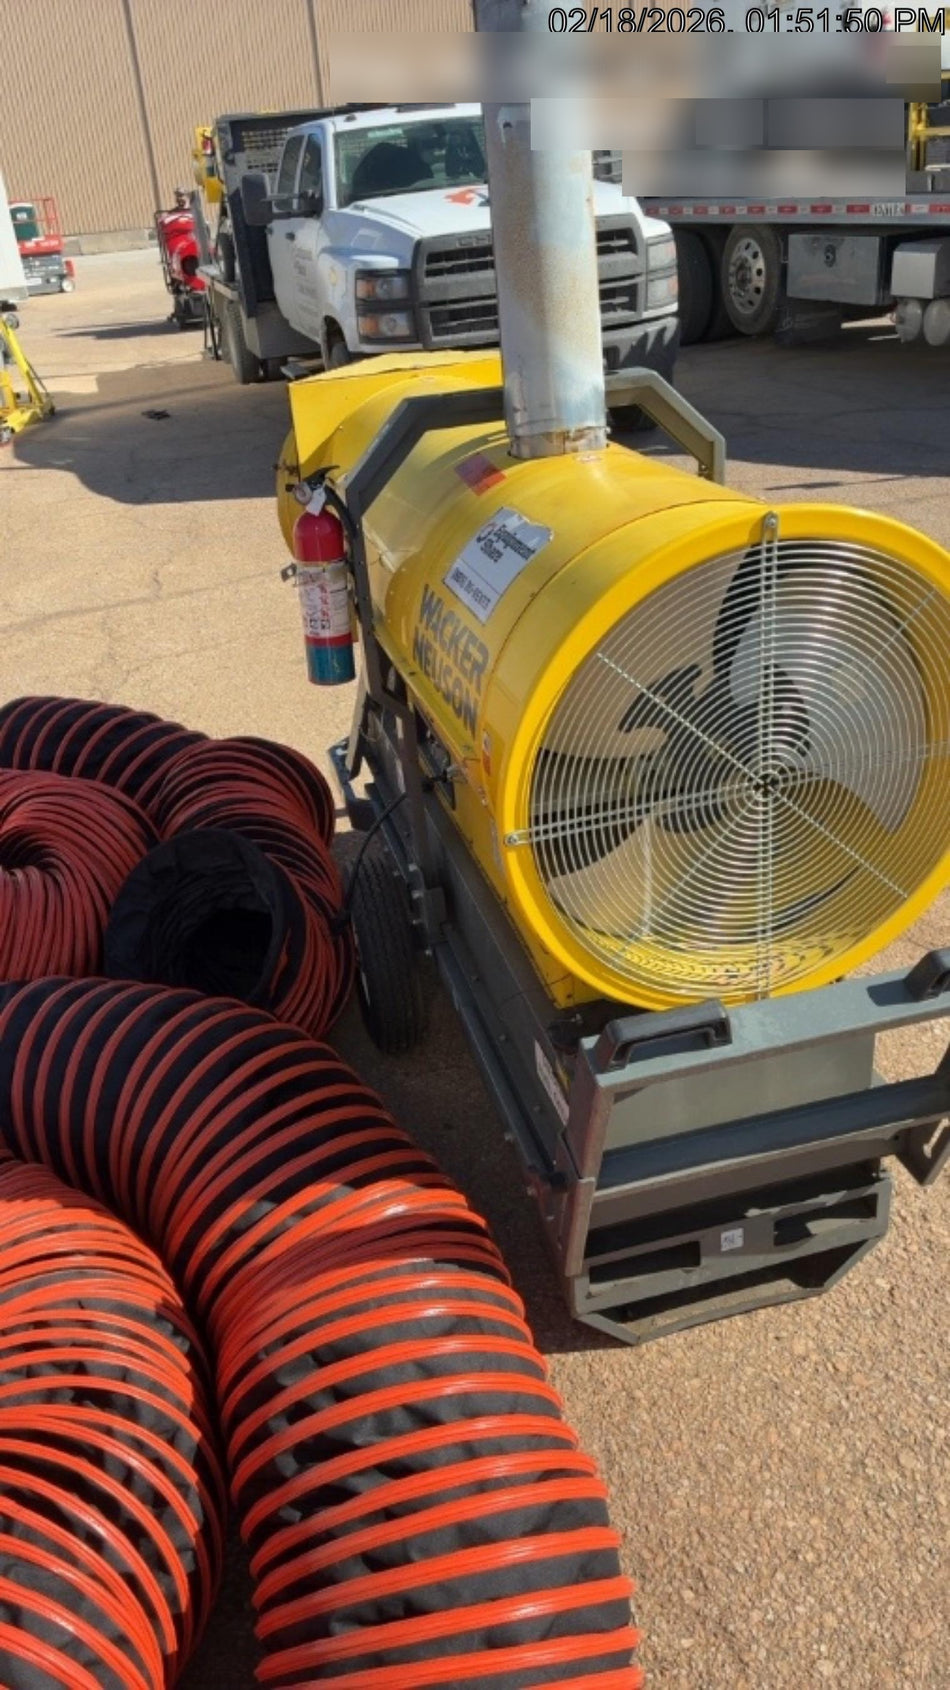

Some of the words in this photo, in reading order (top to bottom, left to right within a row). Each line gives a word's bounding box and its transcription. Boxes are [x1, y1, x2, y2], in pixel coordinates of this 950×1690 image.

[480, 538, 503, 562] Share
[493, 524, 536, 560] Equipment
[420, 584, 490, 696] WACKER
[413, 625, 478, 741] NEUSON
